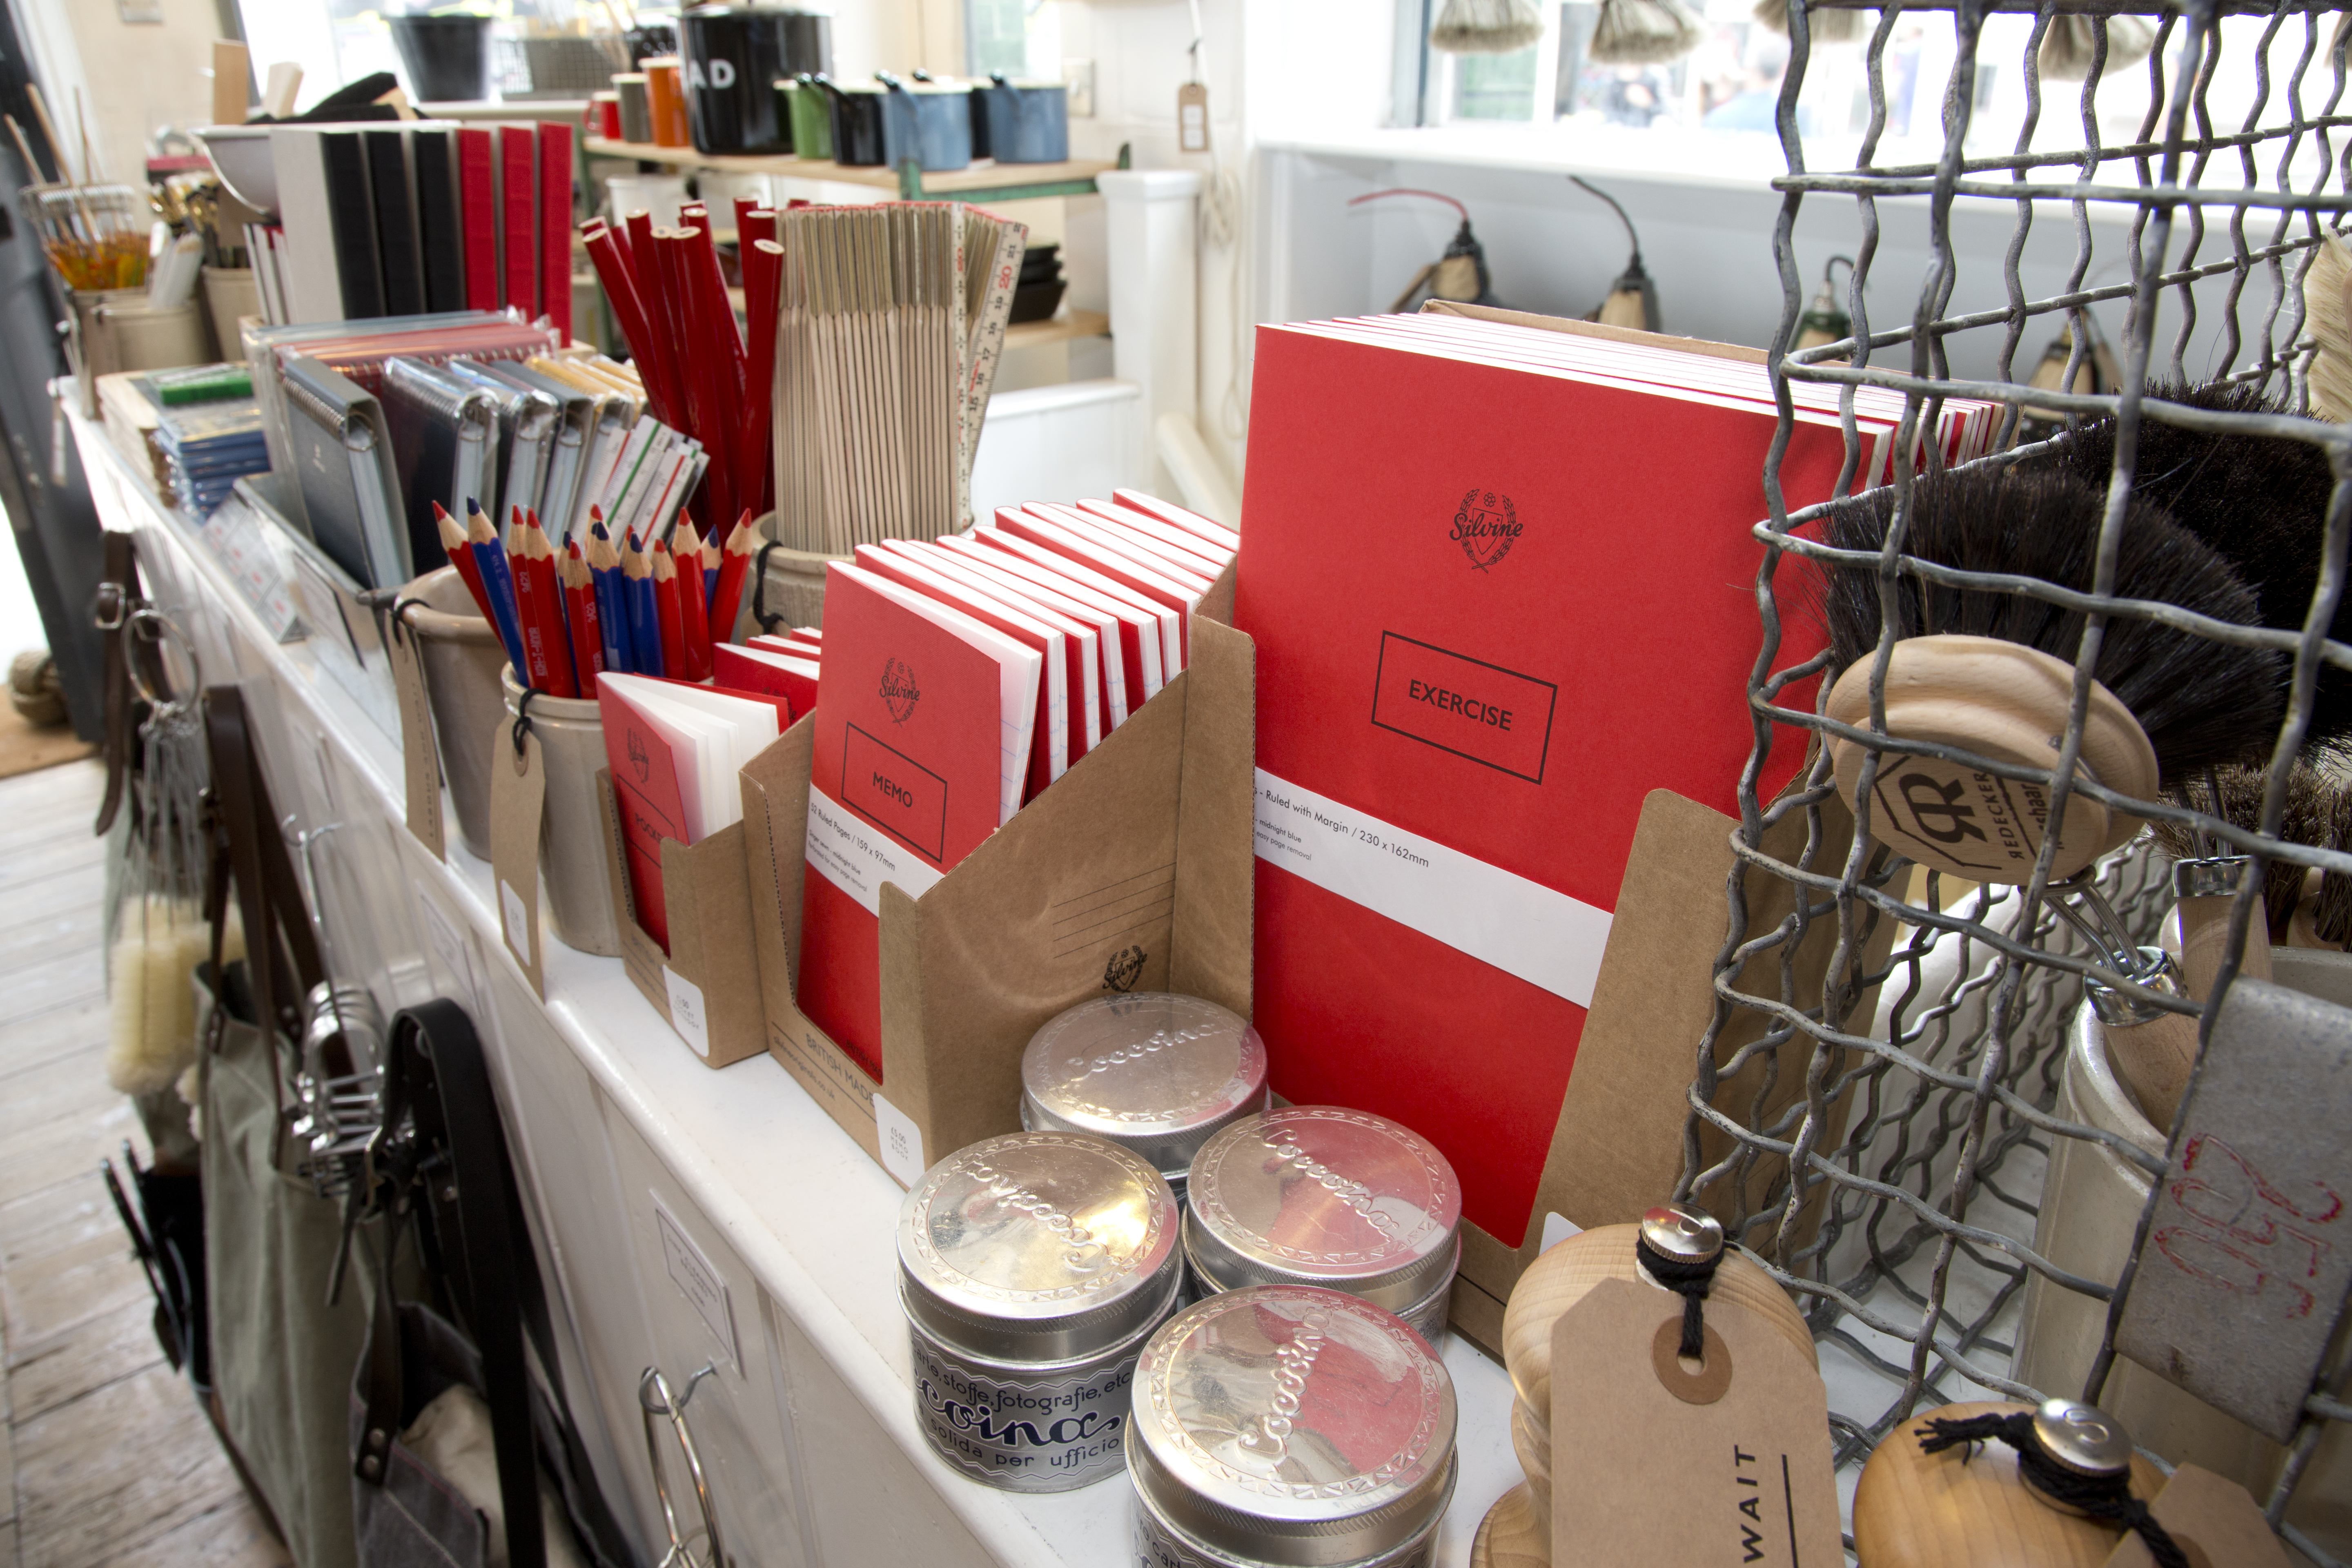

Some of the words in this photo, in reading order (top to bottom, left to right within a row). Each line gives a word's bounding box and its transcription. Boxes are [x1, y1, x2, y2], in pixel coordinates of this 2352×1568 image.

[982, 347, 990, 361] 17
[999, 265, 1013, 290] 20
[1449, 512, 1523, 541] Silvine
[879, 675, 920, 702] Silvine
[1409, 679, 1513, 731] EXERCISE
[873, 771, 913, 808] MEMO
[811, 802, 817, 815] 52
[817, 808, 833, 827] Ruled
[833, 821, 851, 840] Pages
[857, 837, 868, 852] 159
[875, 850, 896, 871] 97mm
[1256, 831, 1269, 842] easy
[1270, 838, 1285, 849] page
[1287, 846, 1312, 861] removal
[1259, 819, 1286, 836] midnight
[1288, 831, 1302, 843] blue
[1266, 790, 1290, 809] Ruled
[1293, 804, 1312, 818] with
[1314, 811, 1349, 834] Margin
[1359, 830, 1379, 846] 230
[1382, 842, 1388, 851] x
[1391, 843, 1429, 868] 162mm
[833, 850, 851, 868] midnight
[851, 863, 861, 875] blue
[851, 877, 868, 892] removal
[1102, 953, 1148, 989] Silvine
[806, 1033, 842, 1077] BRITISH
[844, 1069, 875, 1108] MADE
[1062, 1024, 1226, 1089] Coccoina
[891, 1143, 909, 1161] BOOK
[1259, 1127, 1400, 1243] Coccoina
[943, 1374, 994, 1406] stoffe,
[993, 1387, 1102, 1416] fotografie,
[1234, 1306, 1330, 1476] Coccoina
[931, 1418, 983, 1458] solida
[995, 1453, 1034, 1467] per
[1050, 1438, 1120, 1469] ufficio
[1733, 1444, 1764, 1563] WAIT
